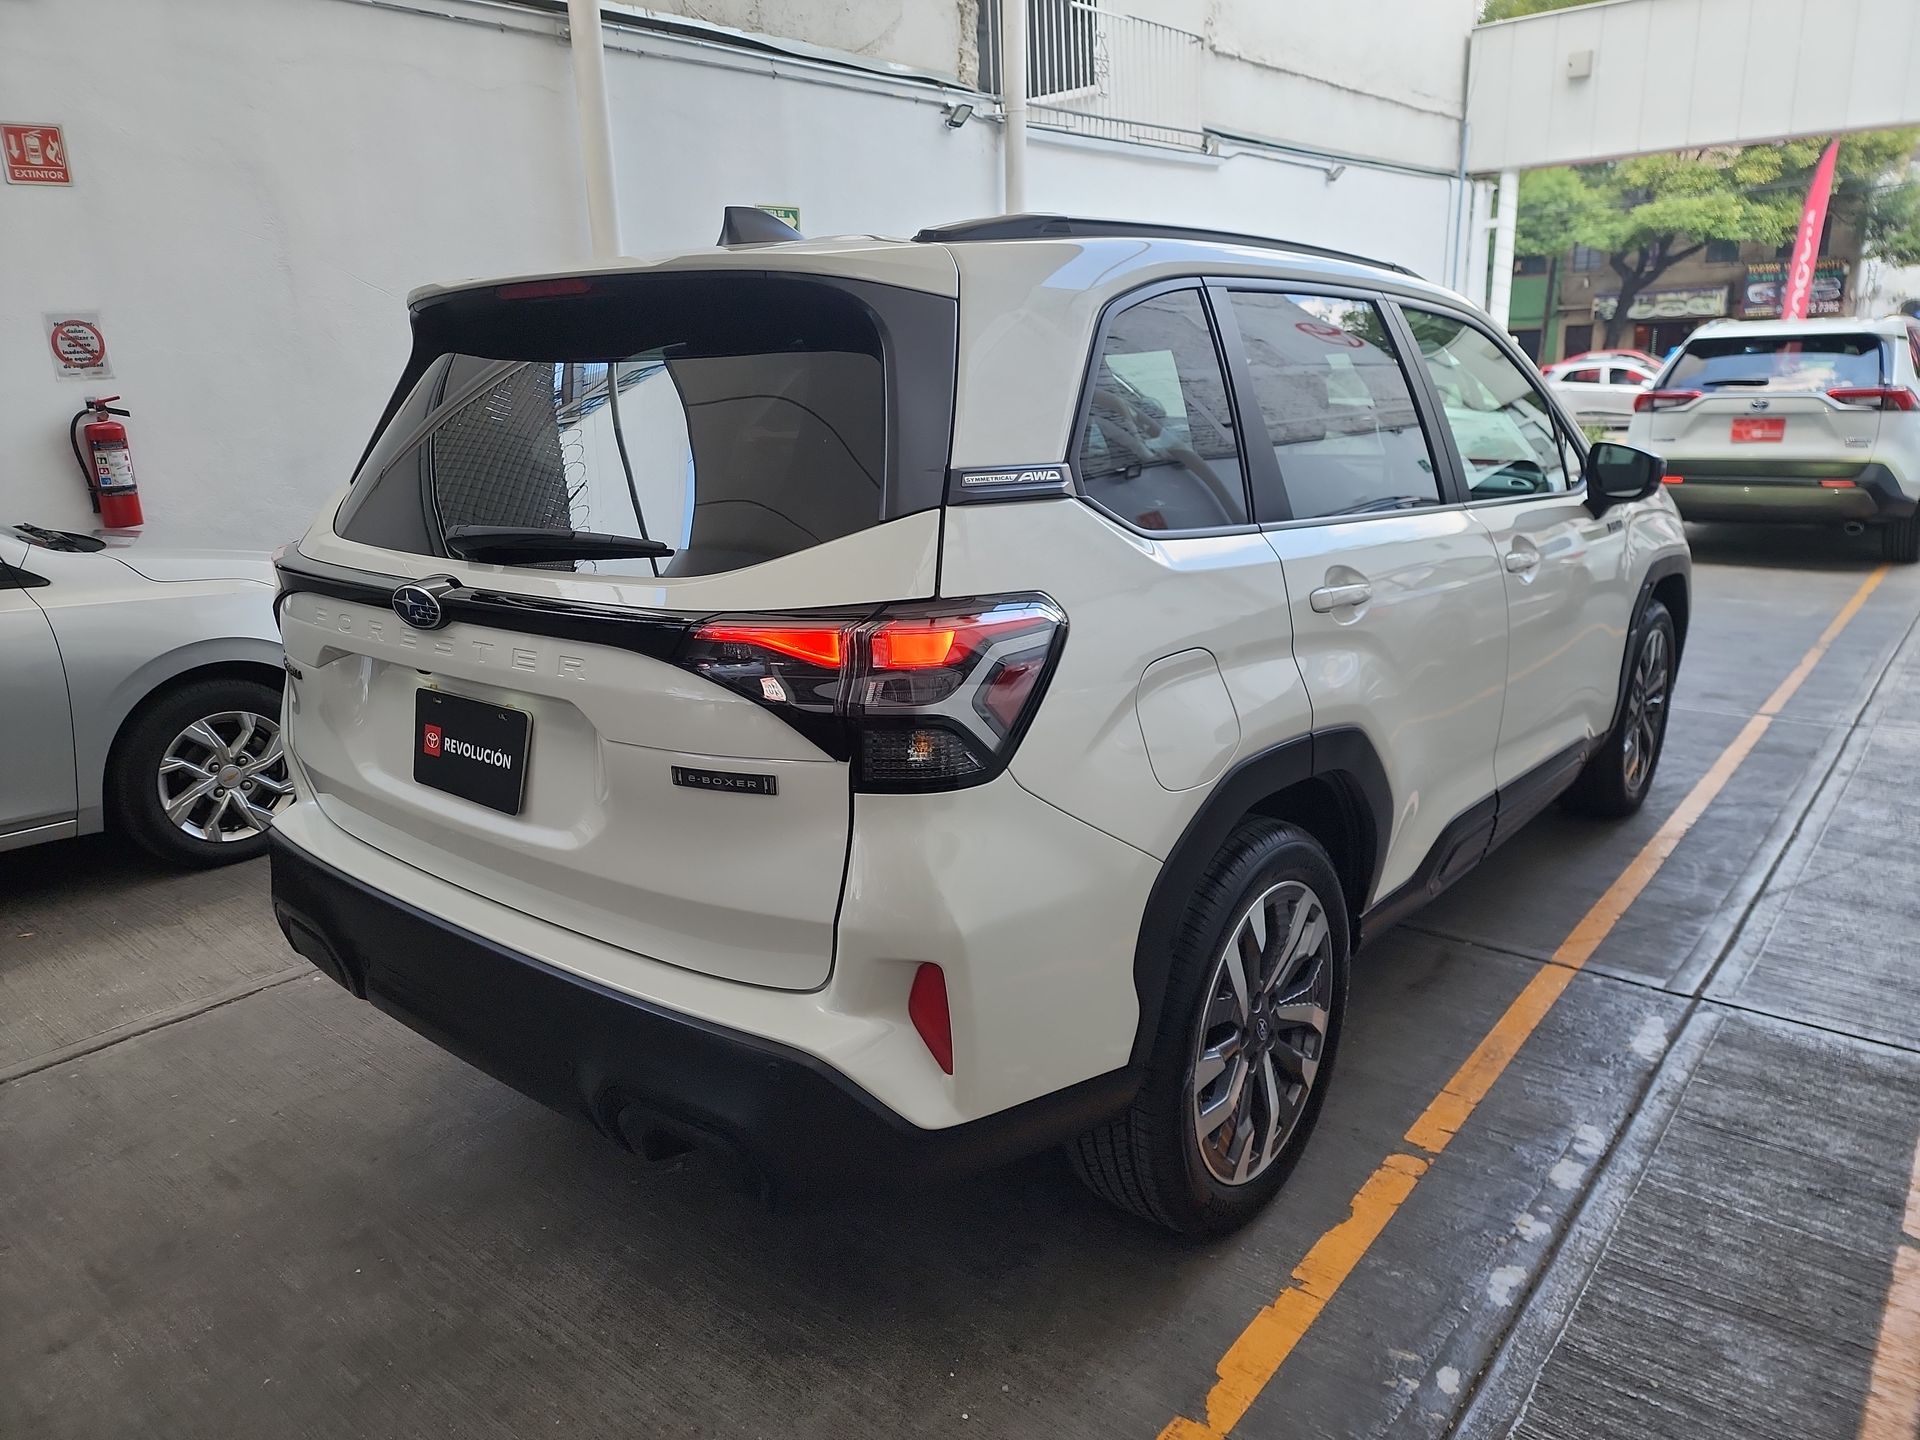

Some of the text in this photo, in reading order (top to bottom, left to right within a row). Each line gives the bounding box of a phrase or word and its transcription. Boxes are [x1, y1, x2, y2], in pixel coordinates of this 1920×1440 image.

[14, 169, 65, 179] EXTINTOR
[965, 471, 1061, 483] SYMMETRICAL AWD
[314, 607, 586, 681] FORESTER
[444, 737, 512, 770] REVOLUCIÓN
[688, 774, 757, 788] e-BOXER
